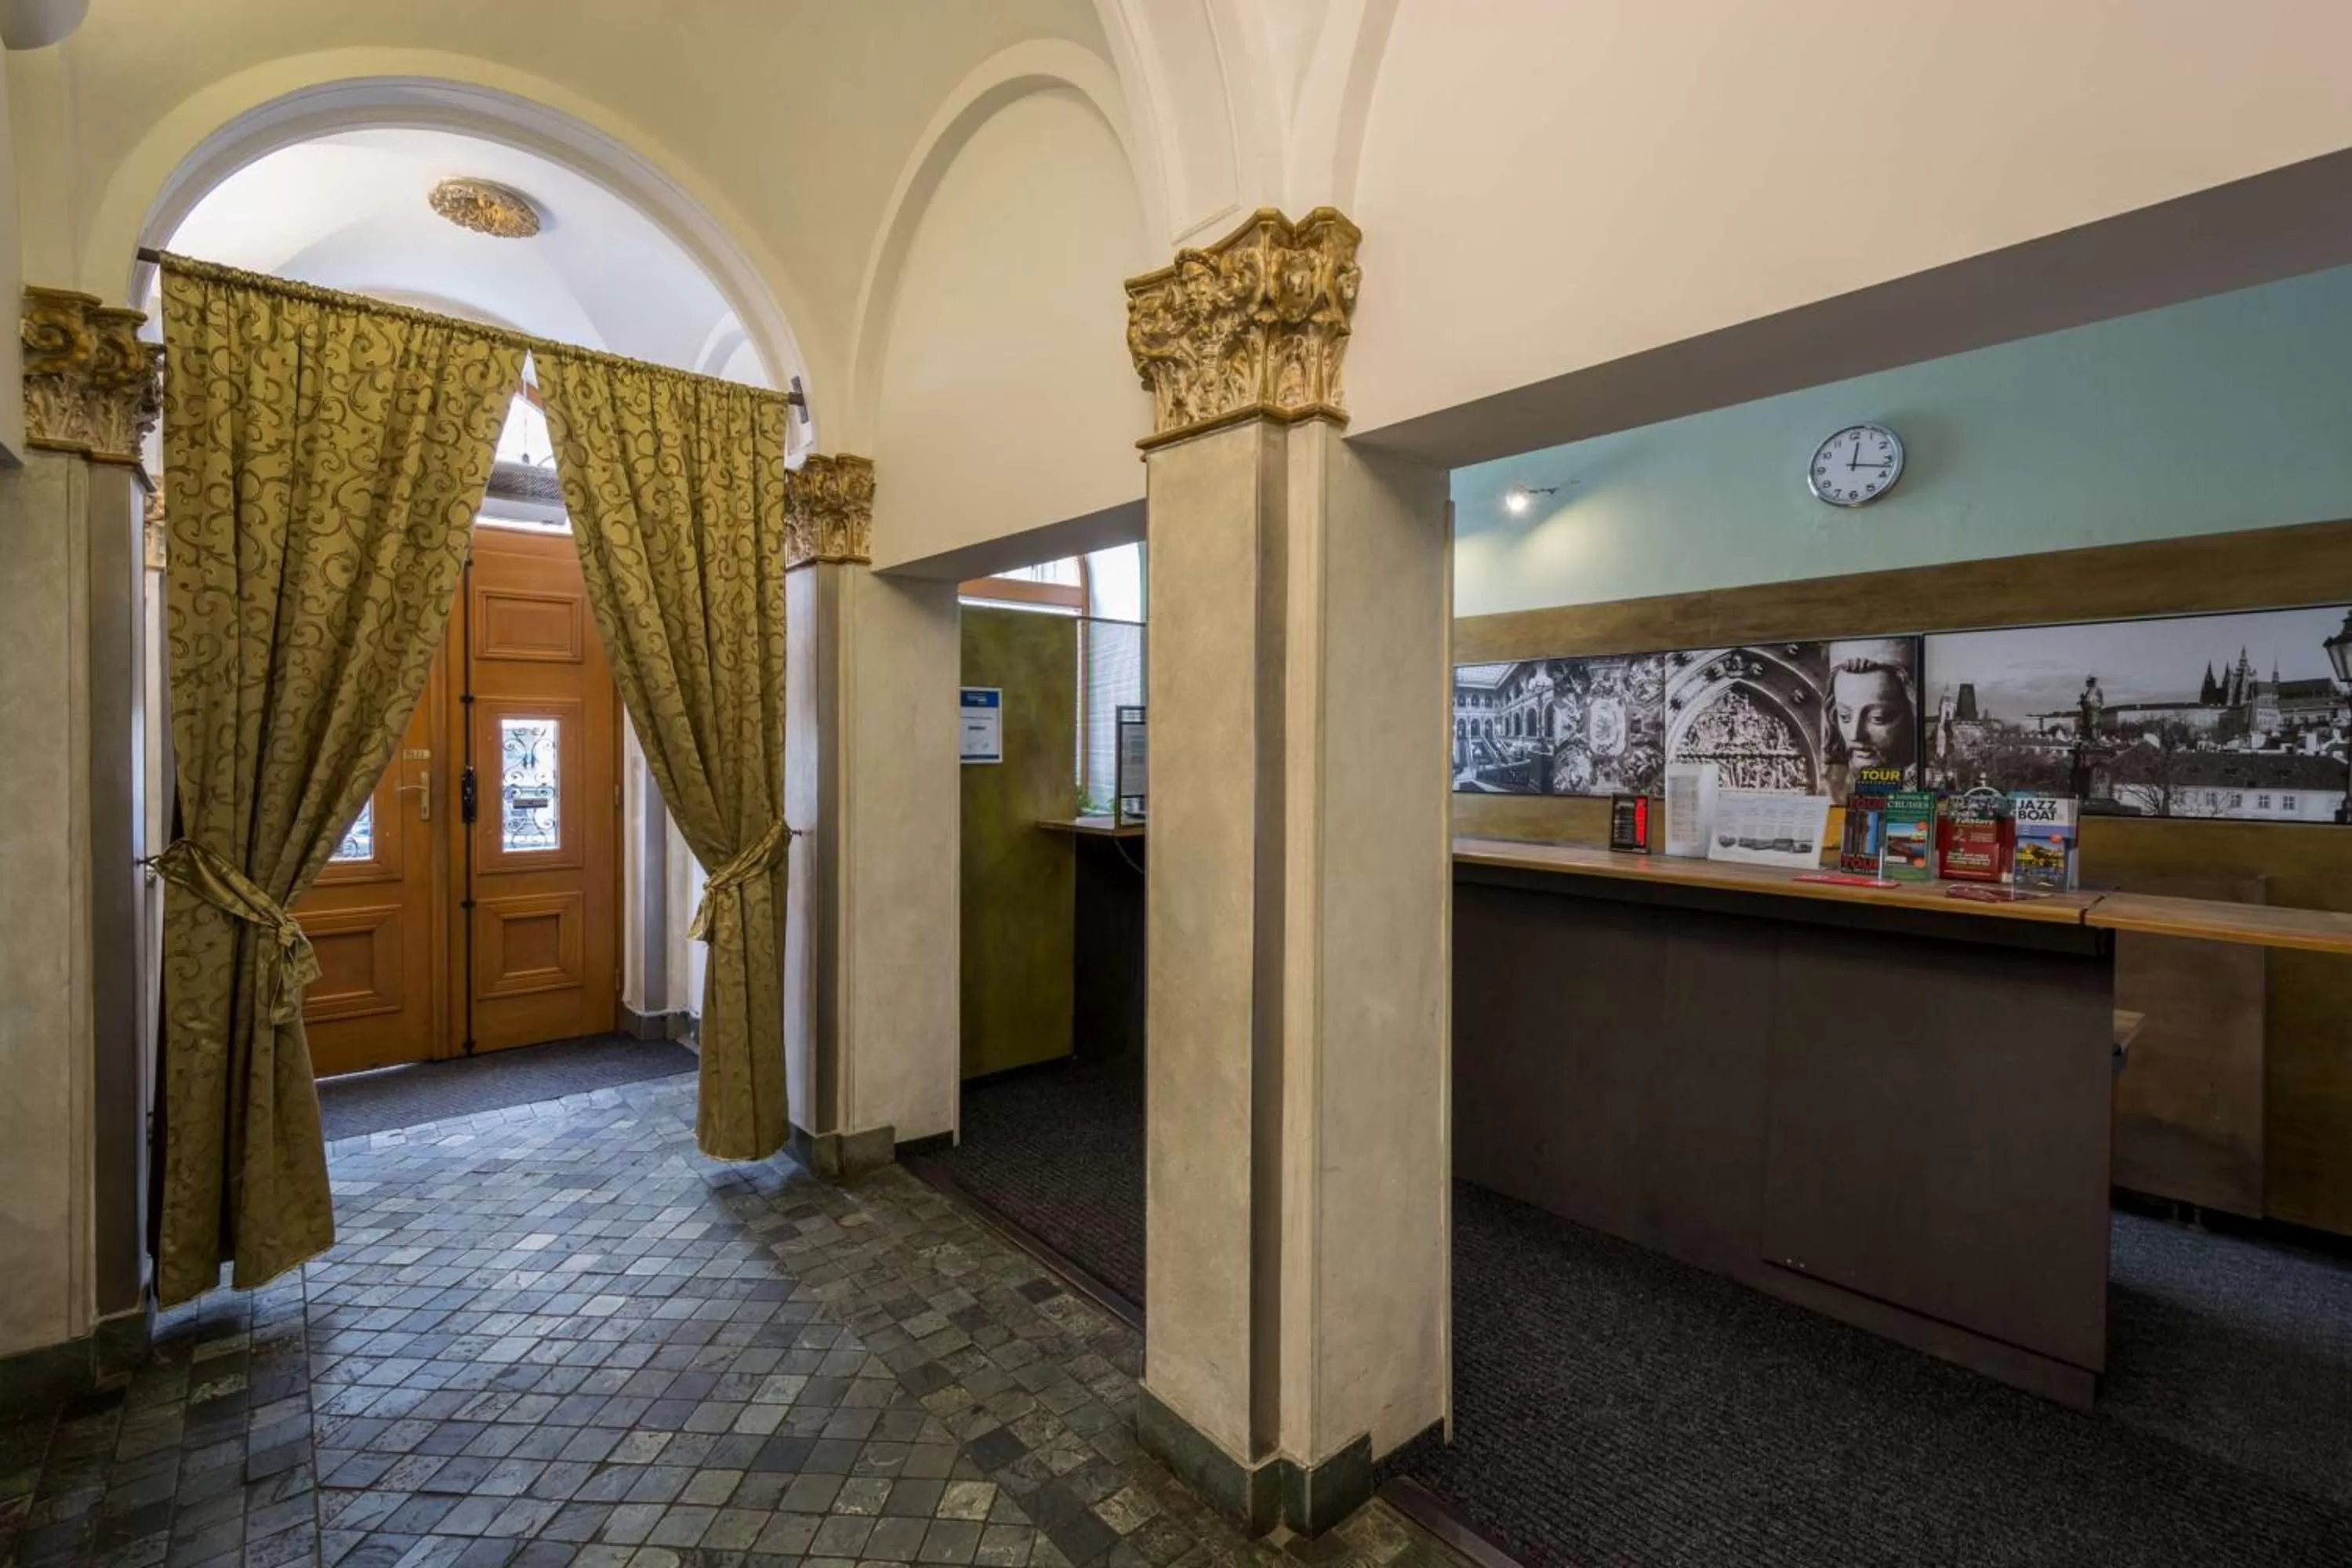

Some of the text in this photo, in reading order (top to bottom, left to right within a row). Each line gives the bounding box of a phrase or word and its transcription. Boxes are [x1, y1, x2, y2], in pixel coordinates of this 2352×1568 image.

[1833, 488, 1842, 499] 7
[1860, 770, 1901, 782] TOUR
[2018, 800, 2057, 810] JAZZ
[2018, 809, 2056, 821] BOAT
